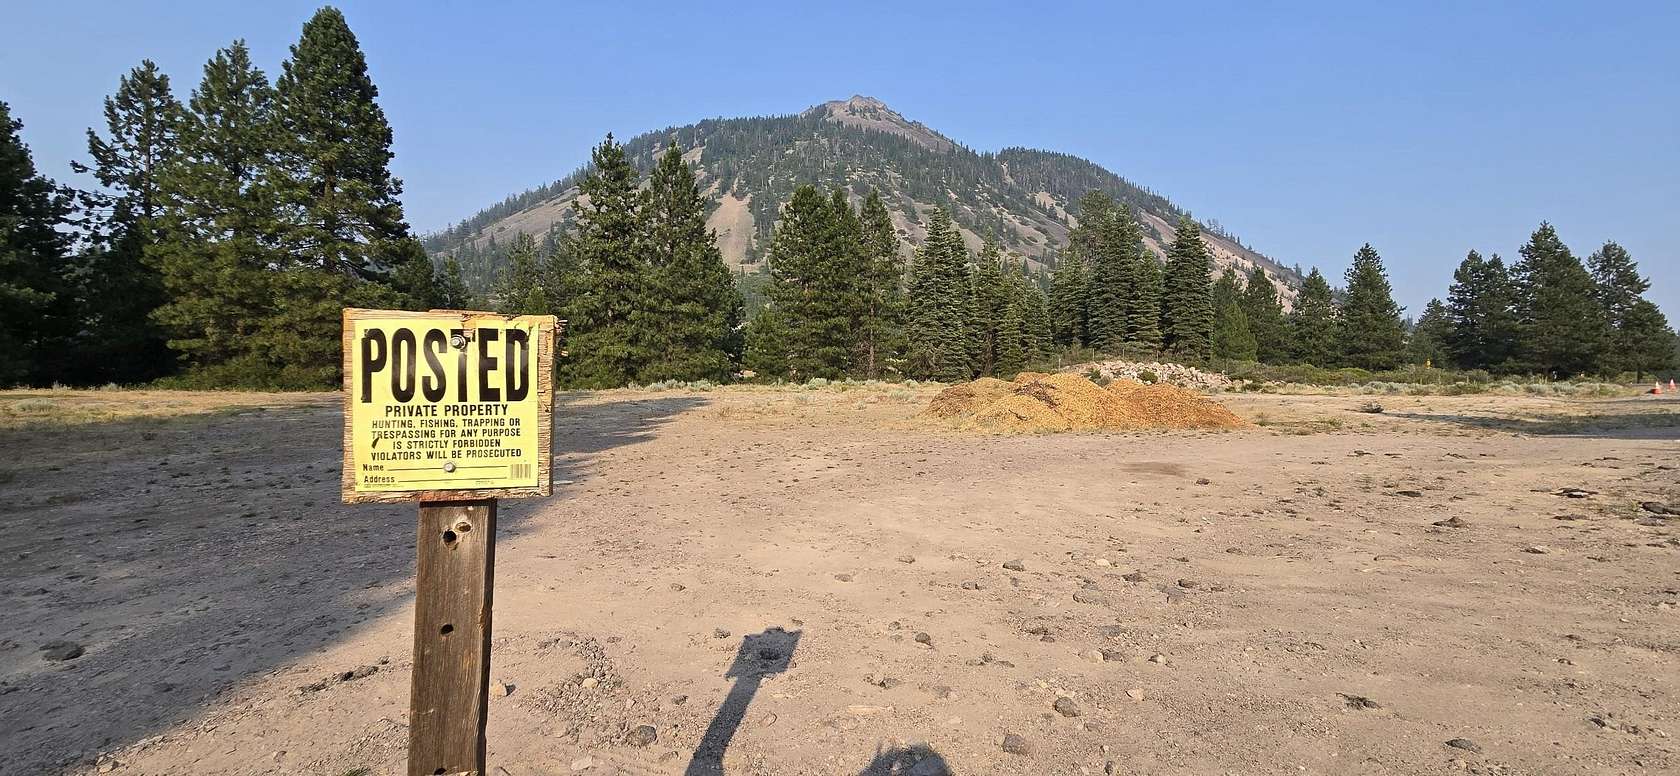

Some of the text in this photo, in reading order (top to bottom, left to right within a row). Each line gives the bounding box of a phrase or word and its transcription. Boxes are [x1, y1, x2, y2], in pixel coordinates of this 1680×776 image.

[361, 328, 529, 403] POSTED
[386, 404, 508, 417] PRIVATE PROPERTY
[462, 418, 505, 427] TRAPPING
[509, 418, 520, 426] OR
[372, 428, 521, 439] TRESPASSING FOR ANY PURPOSE
[407, 440, 448, 449] STRICTLY
[453, 439, 501, 448] FORBIDDEN
[371, 449, 521, 461] VIOLATORS WILL BE PROSECUTED
